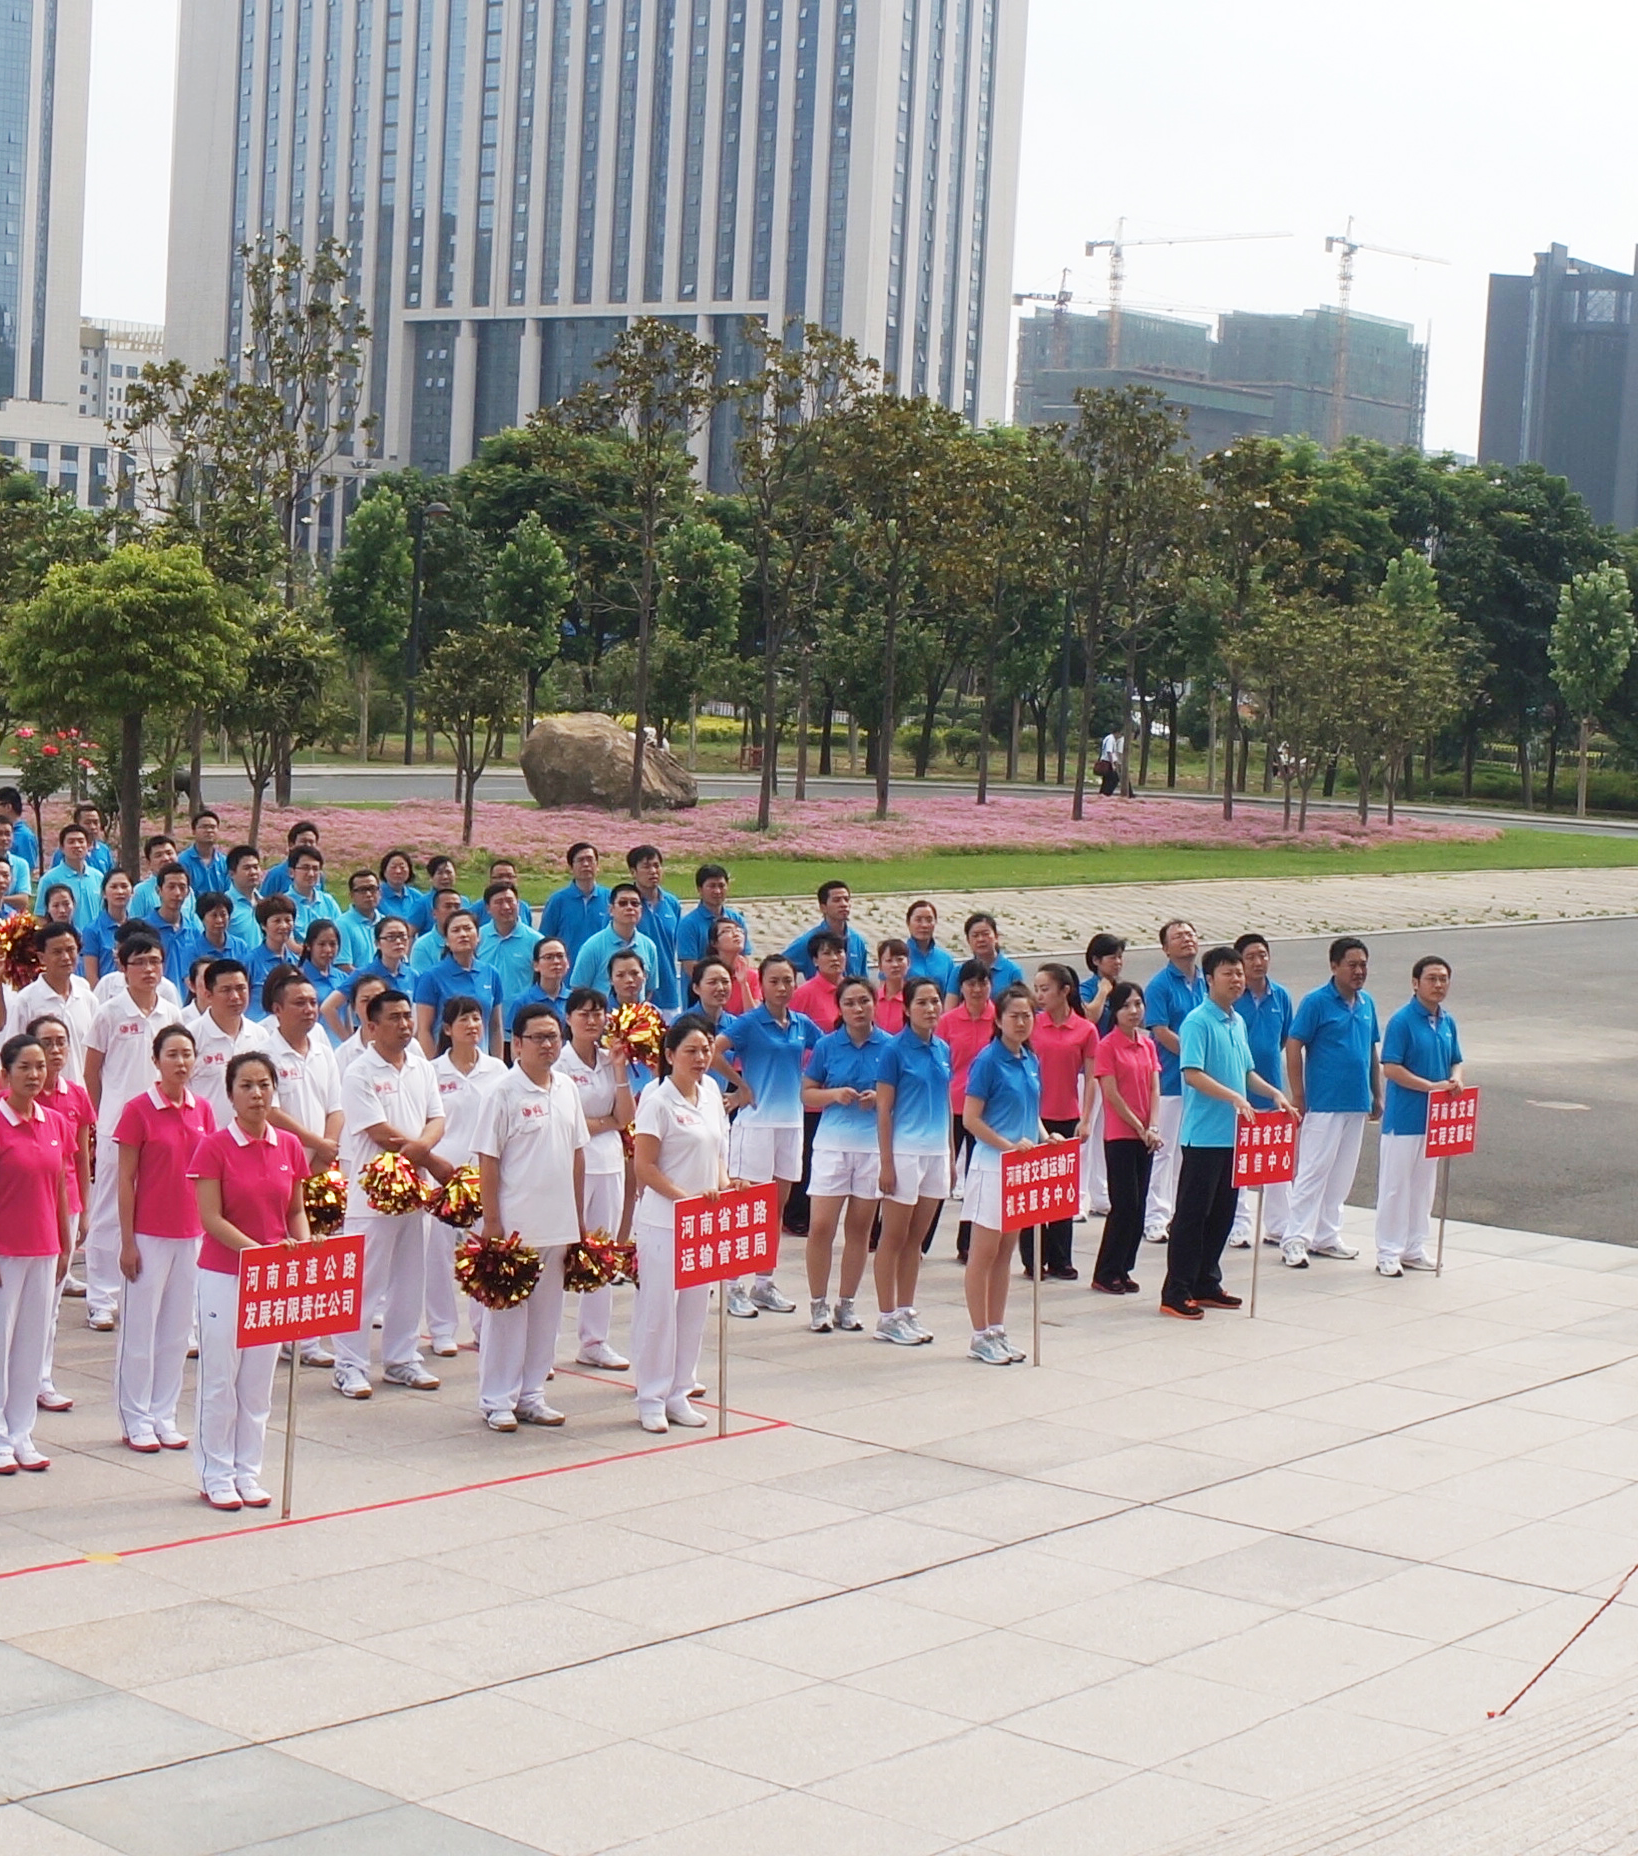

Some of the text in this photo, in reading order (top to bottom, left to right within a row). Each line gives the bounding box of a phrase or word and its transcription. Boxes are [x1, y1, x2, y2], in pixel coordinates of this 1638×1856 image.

[1430, 1098, 1475, 1121] 河南省交通
[1239, 1122, 1293, 1147] 河南省交通
[1428, 1123, 1473, 1147] 工程定额站
[1005, 1152, 1076, 1187] 河南省交通运输厅
[1237, 1150, 1291, 1174] 通信中心
[1005, 1182, 1076, 1218] 机关服务中心
[680, 1198, 768, 1240] 河南省道路
[680, 1231, 767, 1273] 运输管理局
[245, 1251, 357, 1292] 河南高速公路
[243, 1288, 355, 1330] 发展有限责任公司
